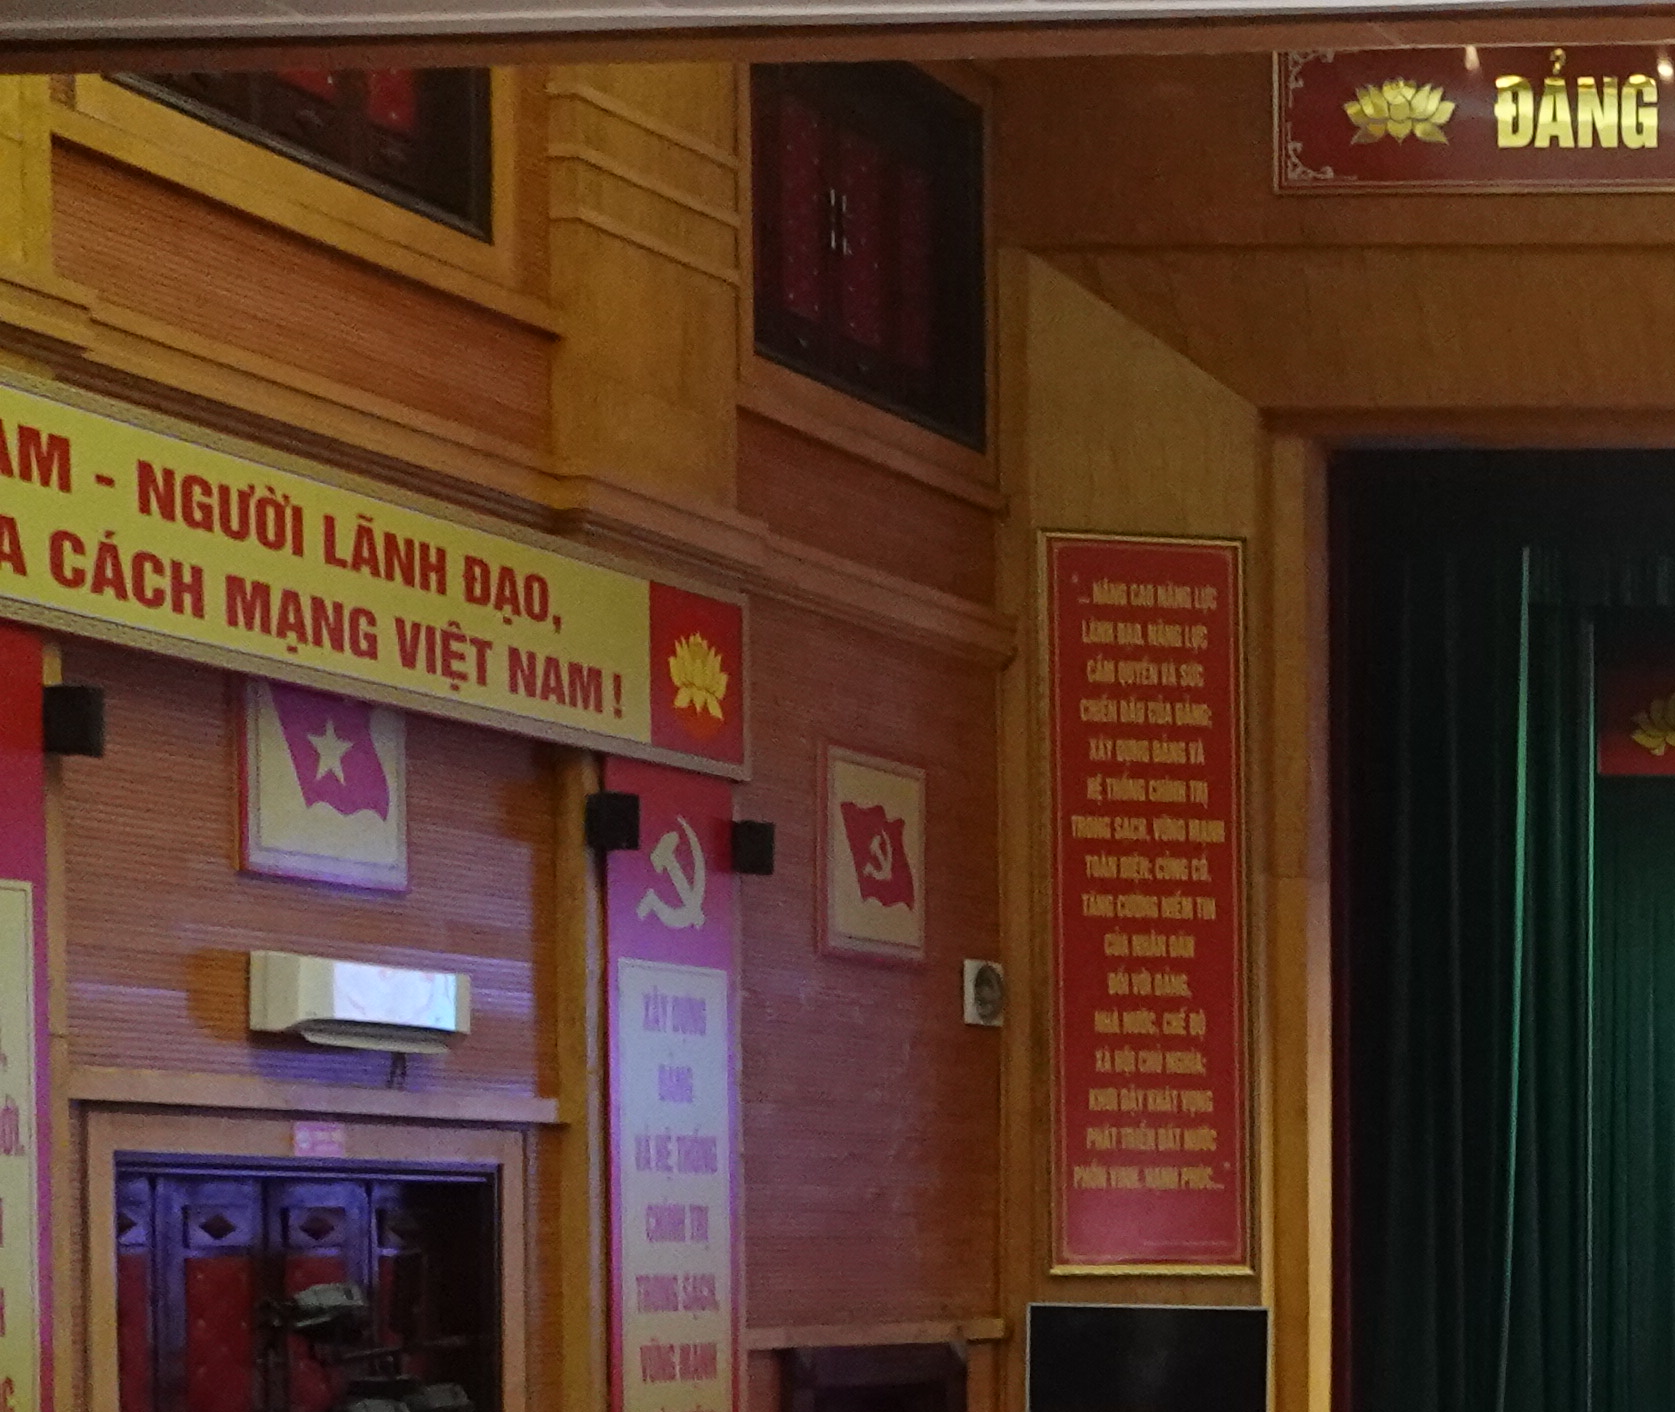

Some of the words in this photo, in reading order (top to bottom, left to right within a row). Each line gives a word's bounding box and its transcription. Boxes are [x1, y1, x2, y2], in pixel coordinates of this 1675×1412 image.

[1494, 47, 1659, 148] ĐẢNG
[49, 529, 205, 620] CÁCH
[225, 574, 379, 660] MẠNG
[393, 617, 494, 690] VIỆT
[95, 474, 115, 487] -
[135, 459, 304, 558] NGƯỜI
[323, 511, 447, 596] LÃNH
[461, 554, 563, 634] ĐẠO,
